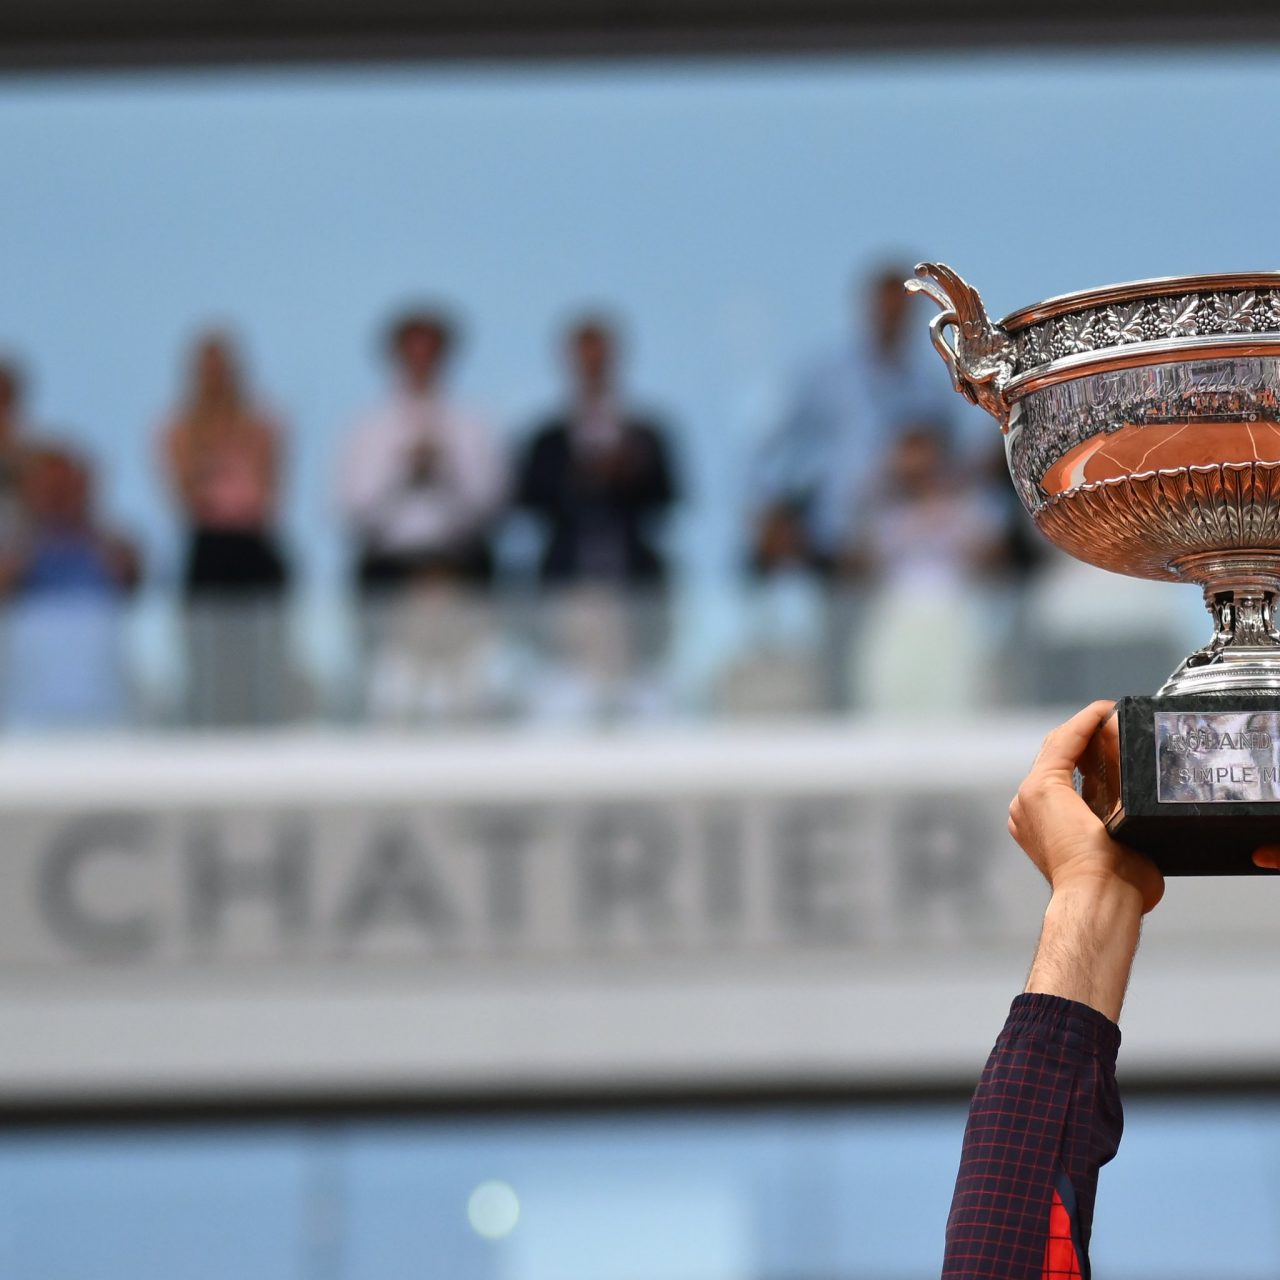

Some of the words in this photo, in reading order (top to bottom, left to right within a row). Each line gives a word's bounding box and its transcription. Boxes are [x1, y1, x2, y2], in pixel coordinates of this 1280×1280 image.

[1167, 731, 1272, 752] ROLAND
[1179, 767, 1256, 784] SIMPLE
[34, 798, 1002, 958] CHATRIER
